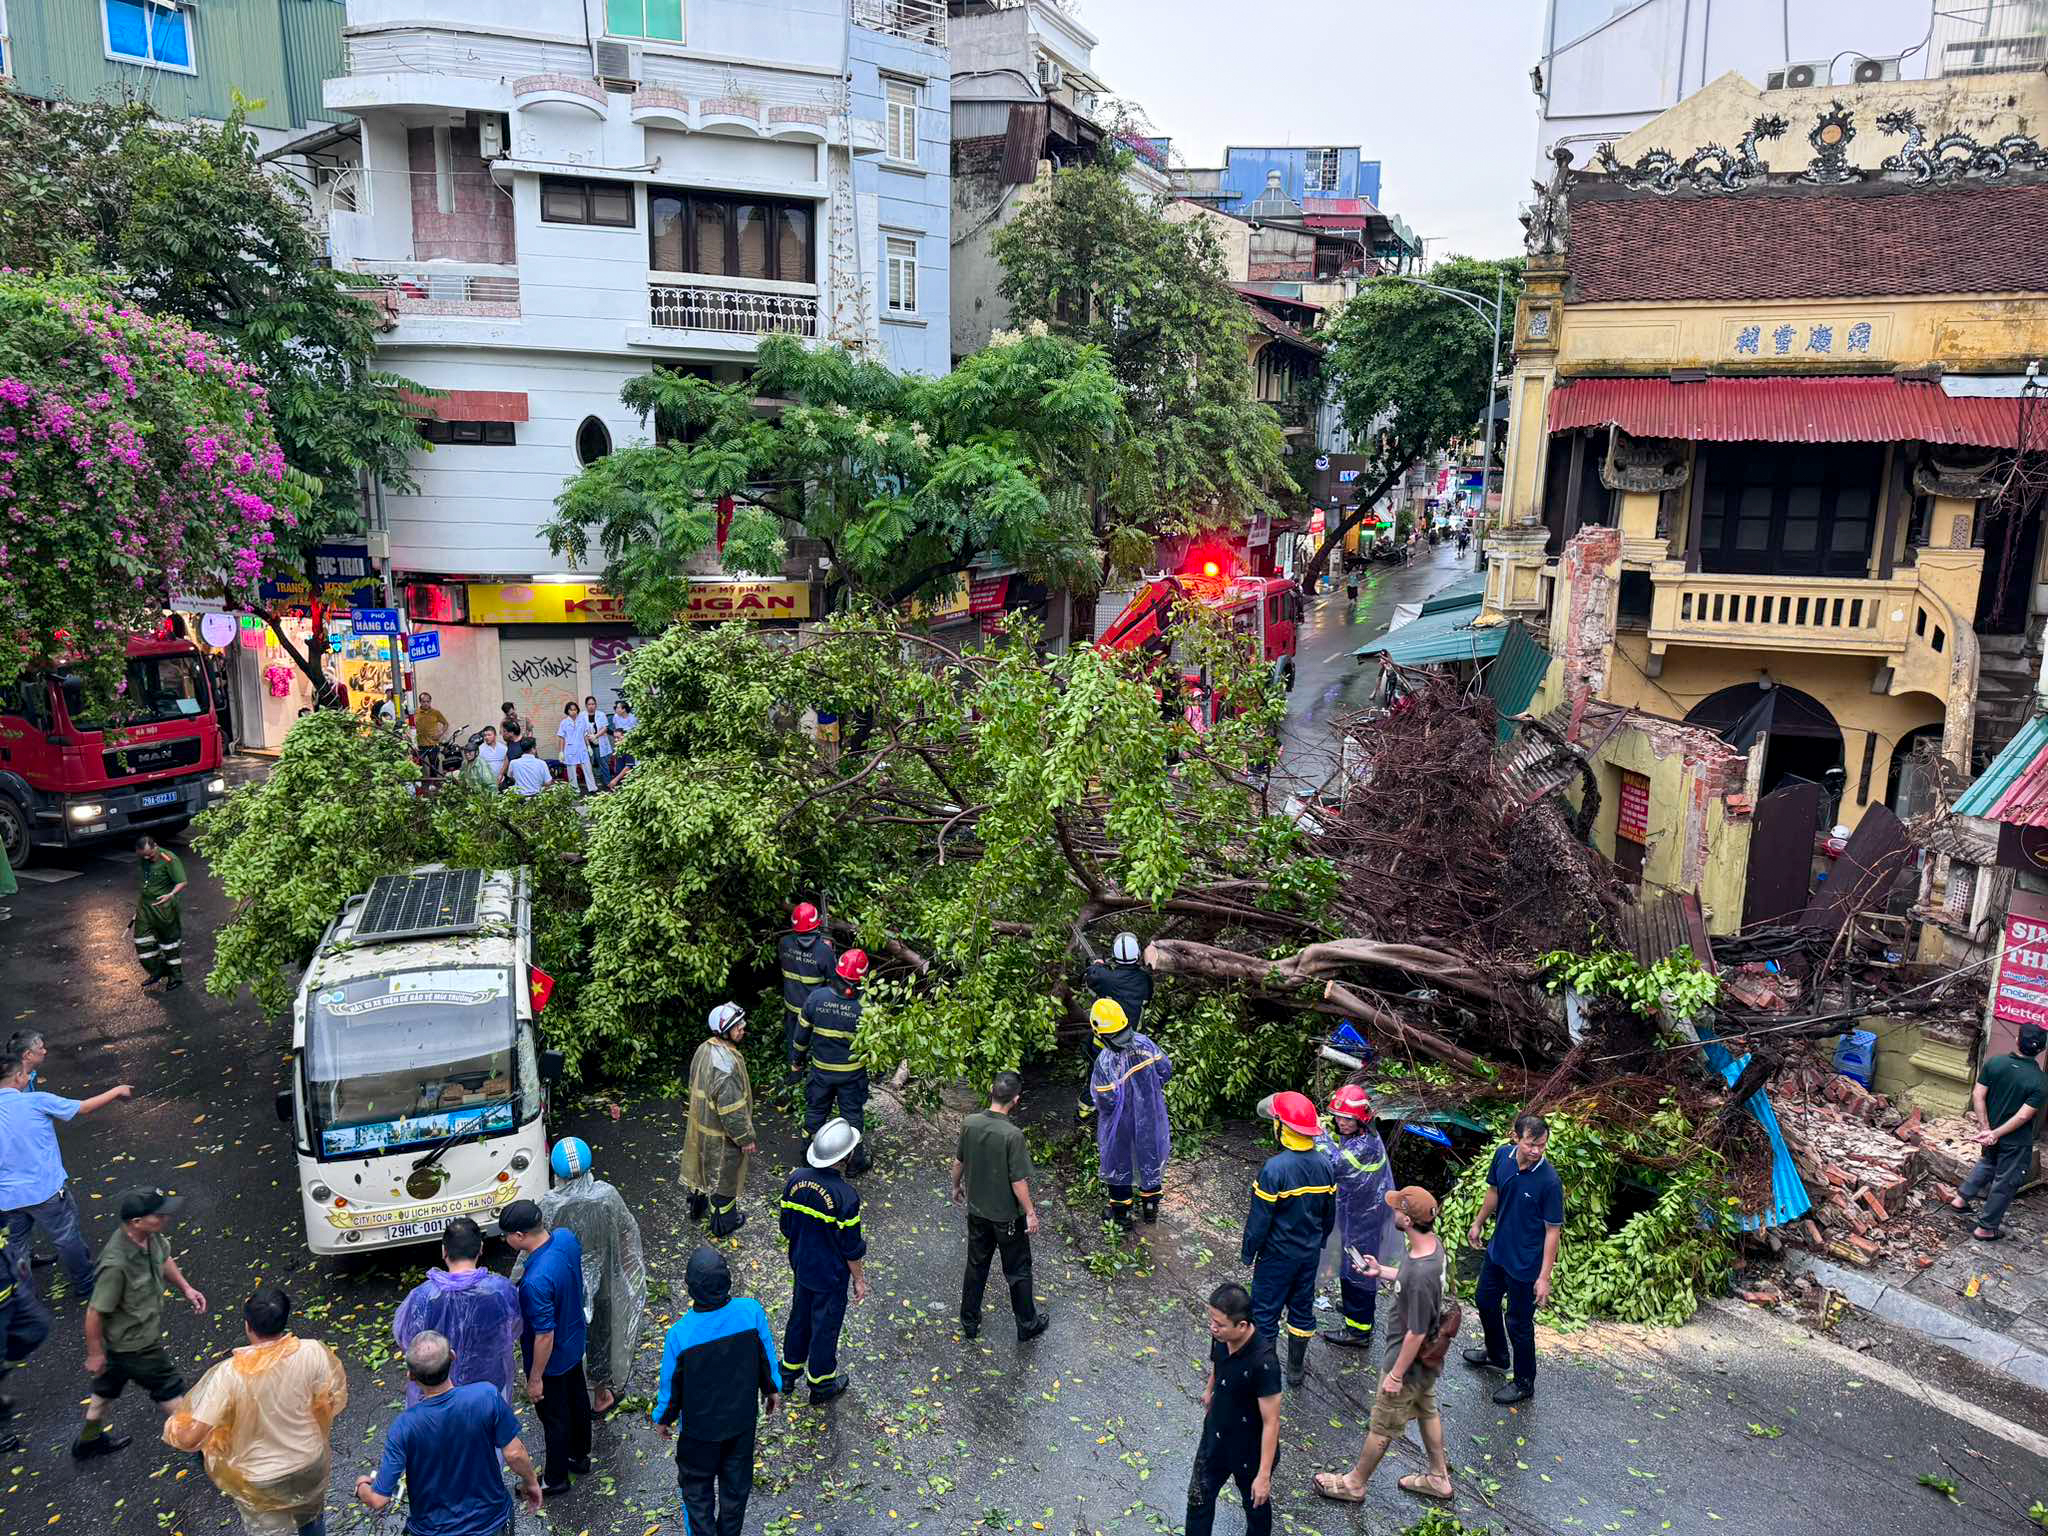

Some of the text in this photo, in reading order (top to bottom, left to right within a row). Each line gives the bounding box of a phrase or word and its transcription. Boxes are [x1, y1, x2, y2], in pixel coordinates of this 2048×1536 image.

[138, 749, 172, 762] MAN
[1999, 1004, 2046, 1023] viettel
[353, 1214, 369, 1226] CITY
[372, 1212, 393, 1223] TOUR
[431, 1203, 448, 1214] PHỐ
